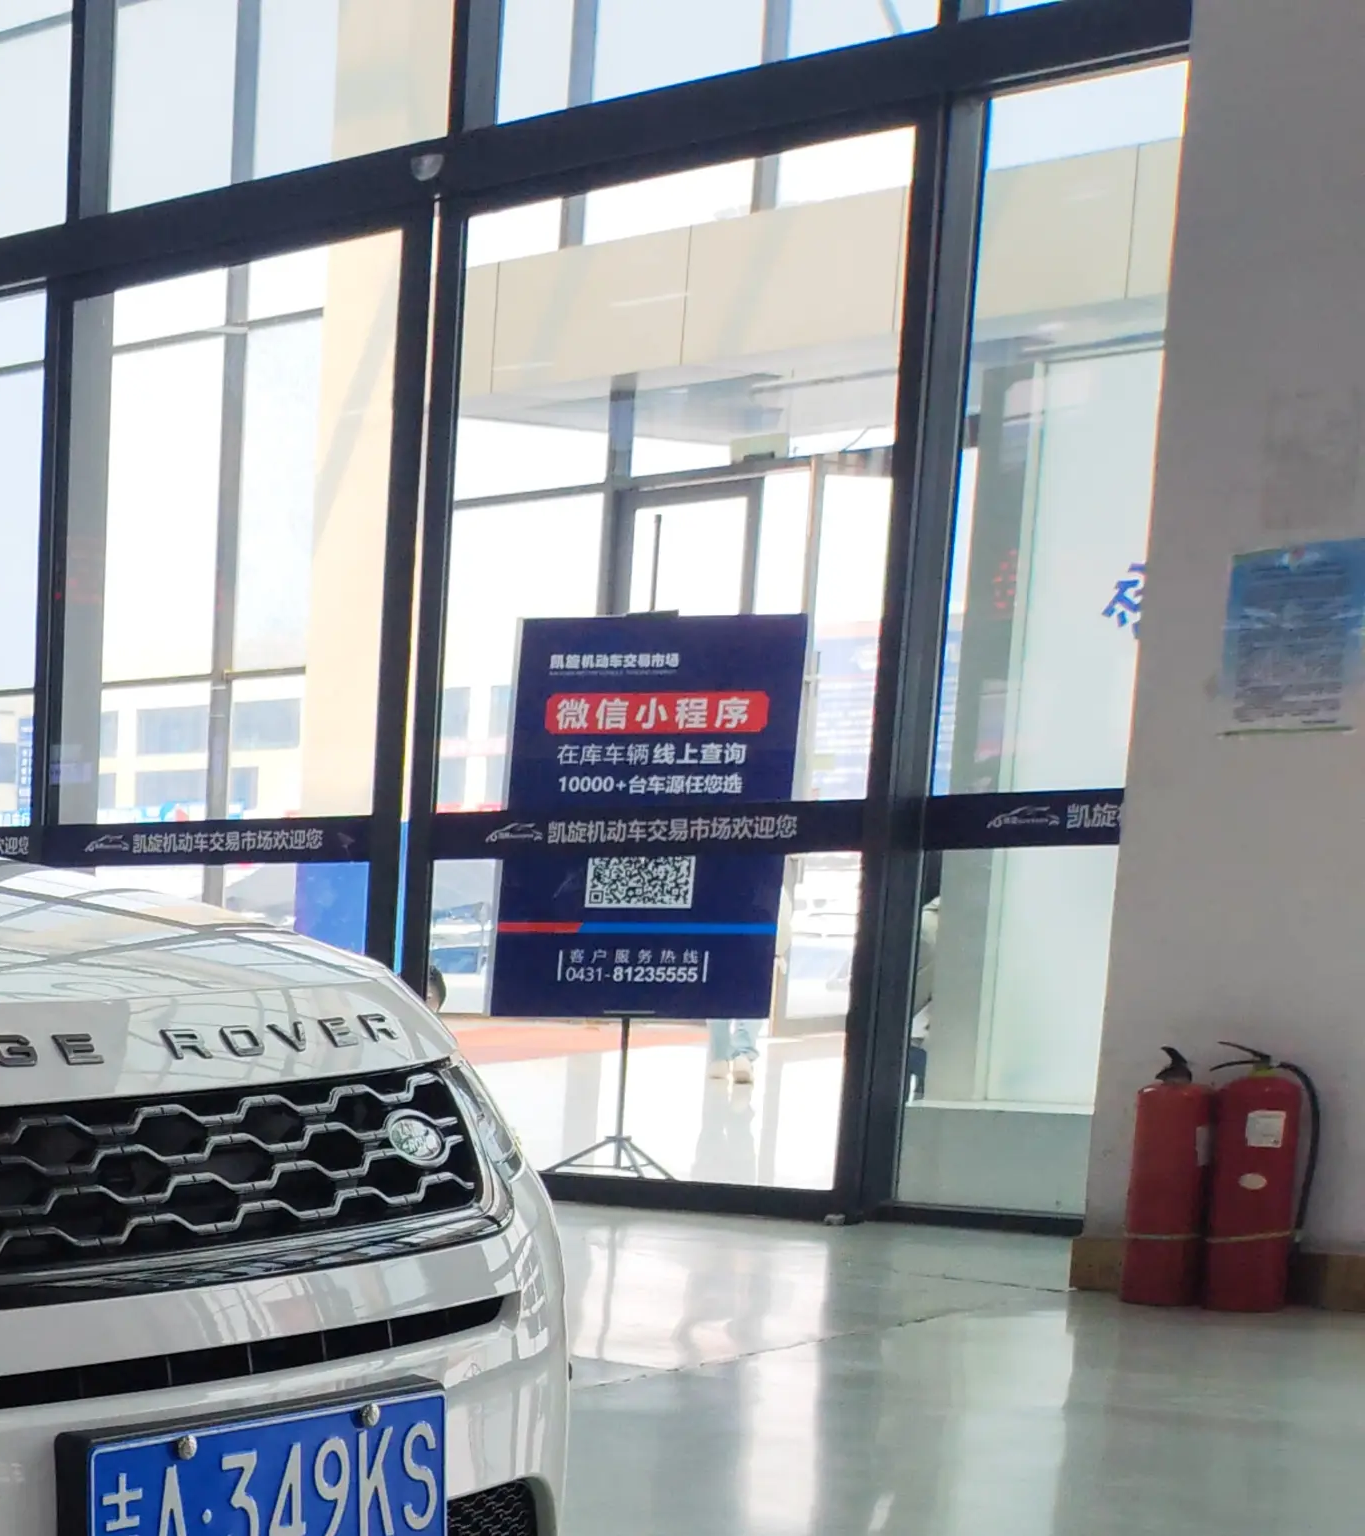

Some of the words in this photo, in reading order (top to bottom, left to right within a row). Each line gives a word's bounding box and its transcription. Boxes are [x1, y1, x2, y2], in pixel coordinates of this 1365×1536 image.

[549, 653, 680, 670] 凯旋机动车交易市场
[555, 697, 750, 730] 微信小程序
[556, 743, 747, 766] 在库车辆线上查询
[557, 772, 743, 794] 10000+台车源任您选
[1066, 802, 1123, 829] 凯旋
[132, 828, 323, 854] 凯旋机动车交易市场欢迎您
[546, 815, 798, 844] 凯旋机动车交易市场欢迎您
[568, 949, 699, 965] 客户服务热线
[565, 966, 699, 983] 0431-81235555
[159, 1012, 400, 1060] ROVER
